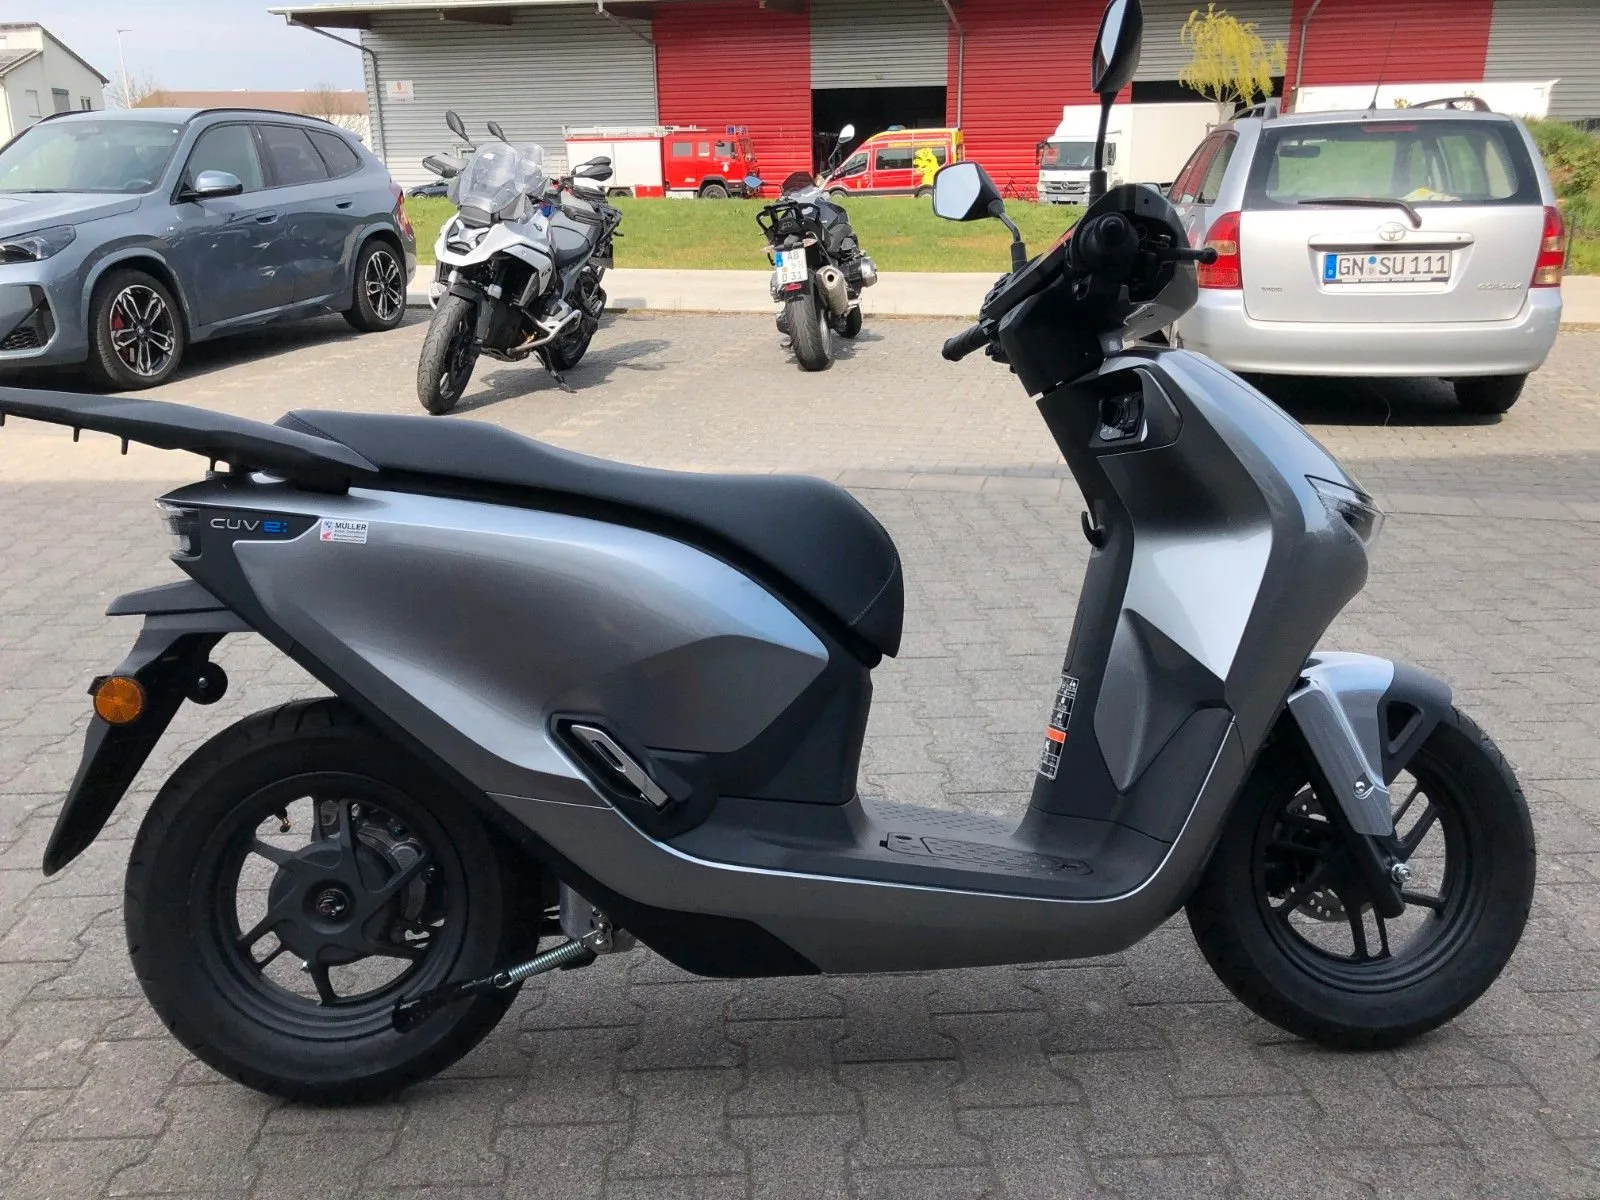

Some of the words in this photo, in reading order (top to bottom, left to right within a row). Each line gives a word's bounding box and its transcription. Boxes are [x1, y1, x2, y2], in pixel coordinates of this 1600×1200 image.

[1339, 257, 1364, 276] GN
[1379, 256, 1405, 275] SU
[1410, 255, 1447, 275] 111
[210, 518, 260, 531] CUV
